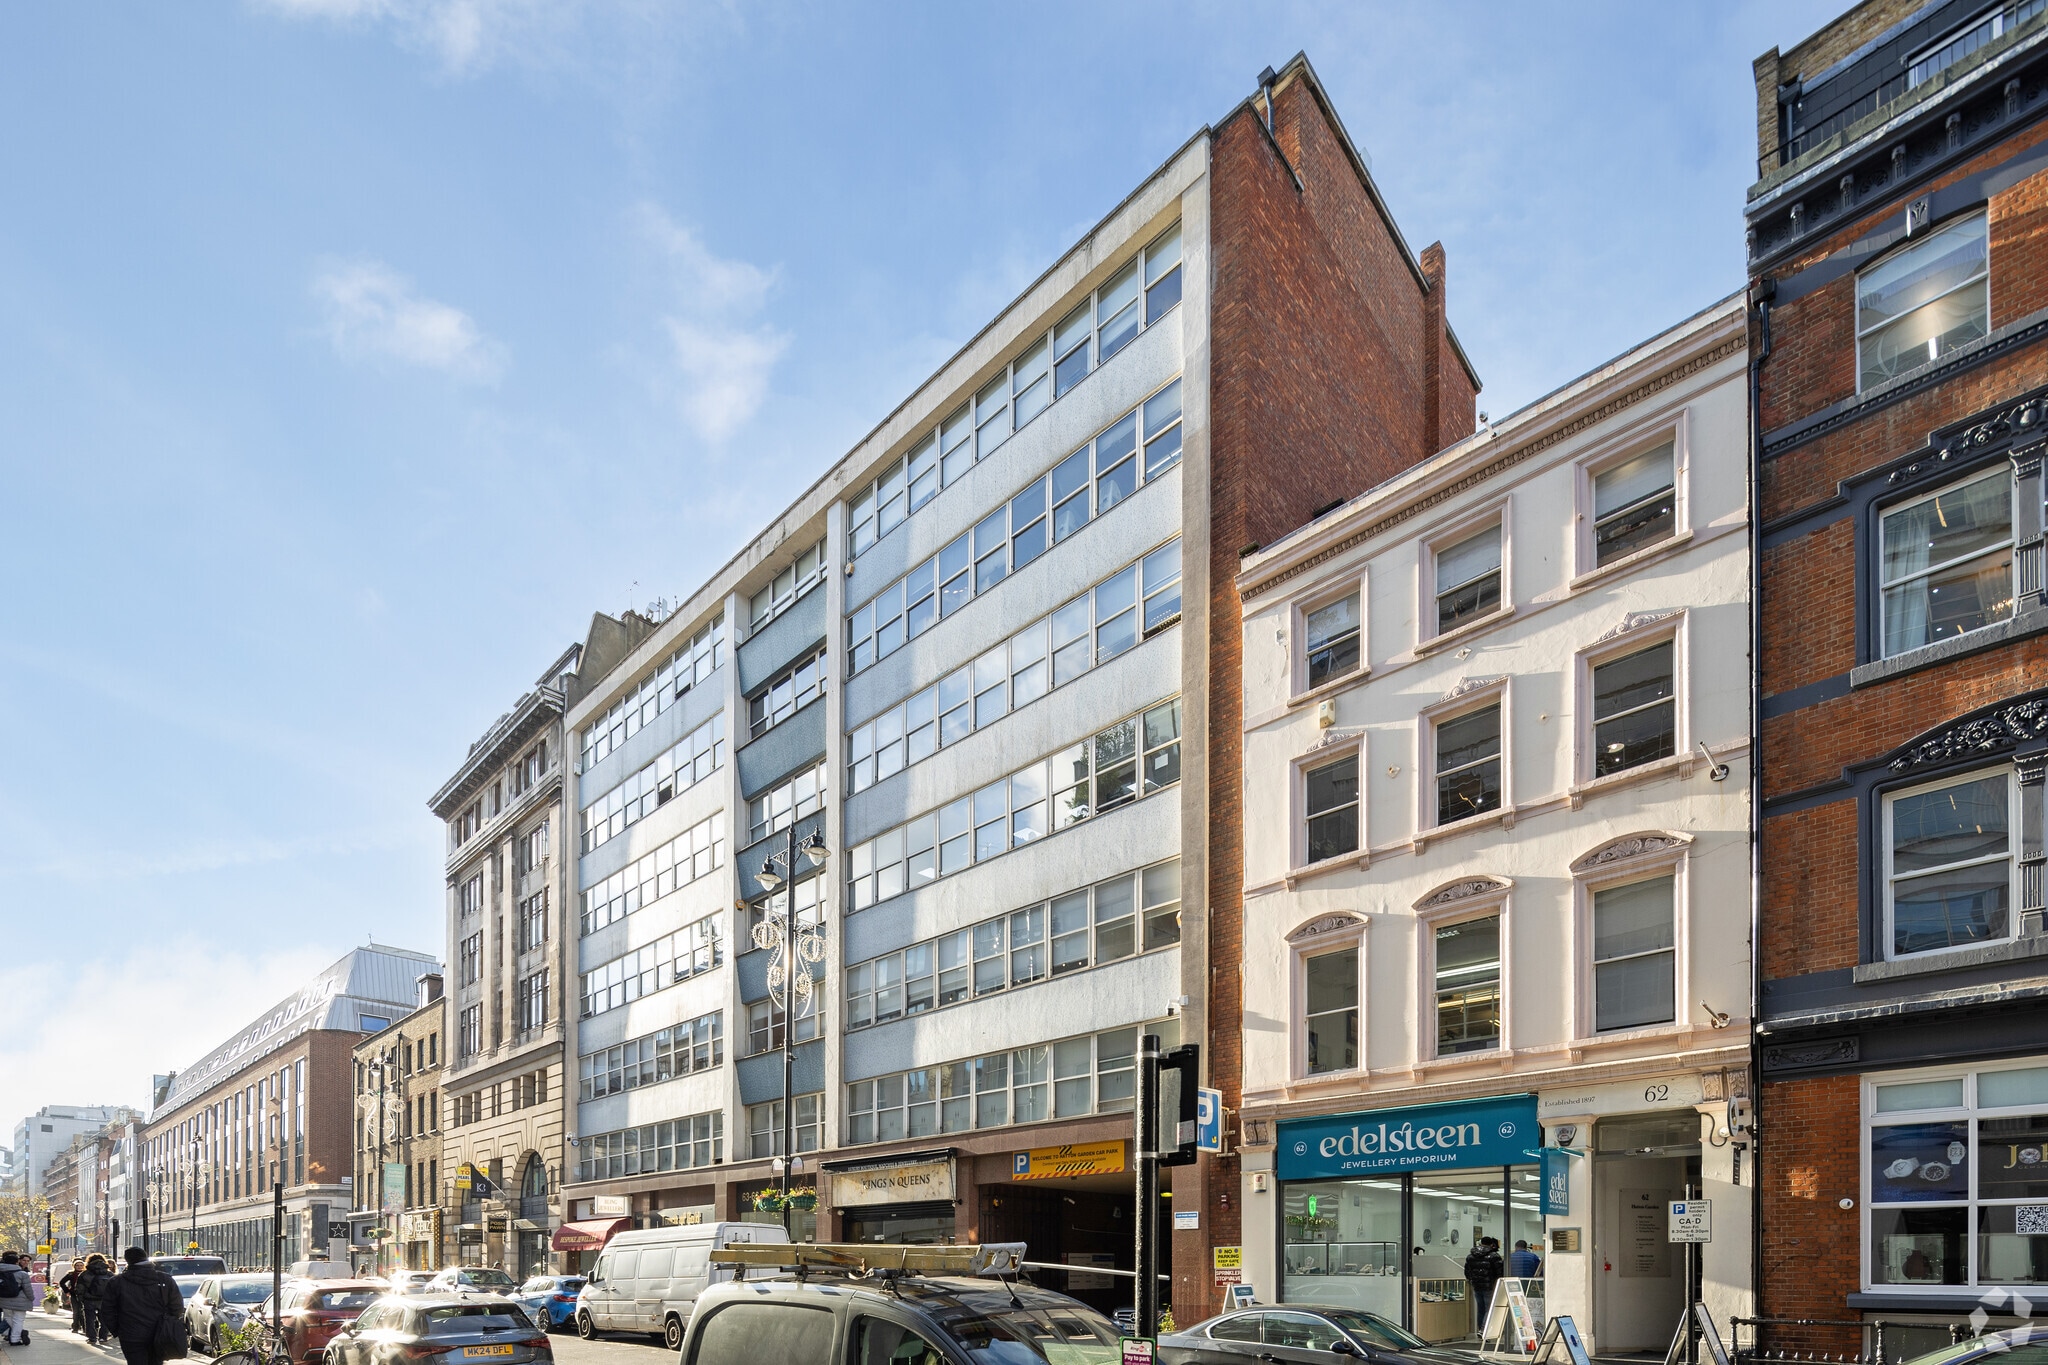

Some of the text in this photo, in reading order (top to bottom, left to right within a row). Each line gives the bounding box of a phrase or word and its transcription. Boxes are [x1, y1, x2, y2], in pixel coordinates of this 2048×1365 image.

[1644, 1084, 1668, 1103] 62
[1545, 1098, 1580, 1107] Established
[1501, 1125, 1512, 1134] 62
[1319, 1122, 1482, 1158] edelsteen
[1016, 1155, 1027, 1172] P
[1341, 1153, 1457, 1169] JEWELLERY EMPORIUM
[862, 1174, 930, 1189] KINGS N QUEENS
[1550, 1172, 1566, 1191] edel
[1549, 1189, 1567, 1205] steen
[1675, 1205, 1683, 1214] P
[467, 1345, 510, 1356] MK24 DFL
